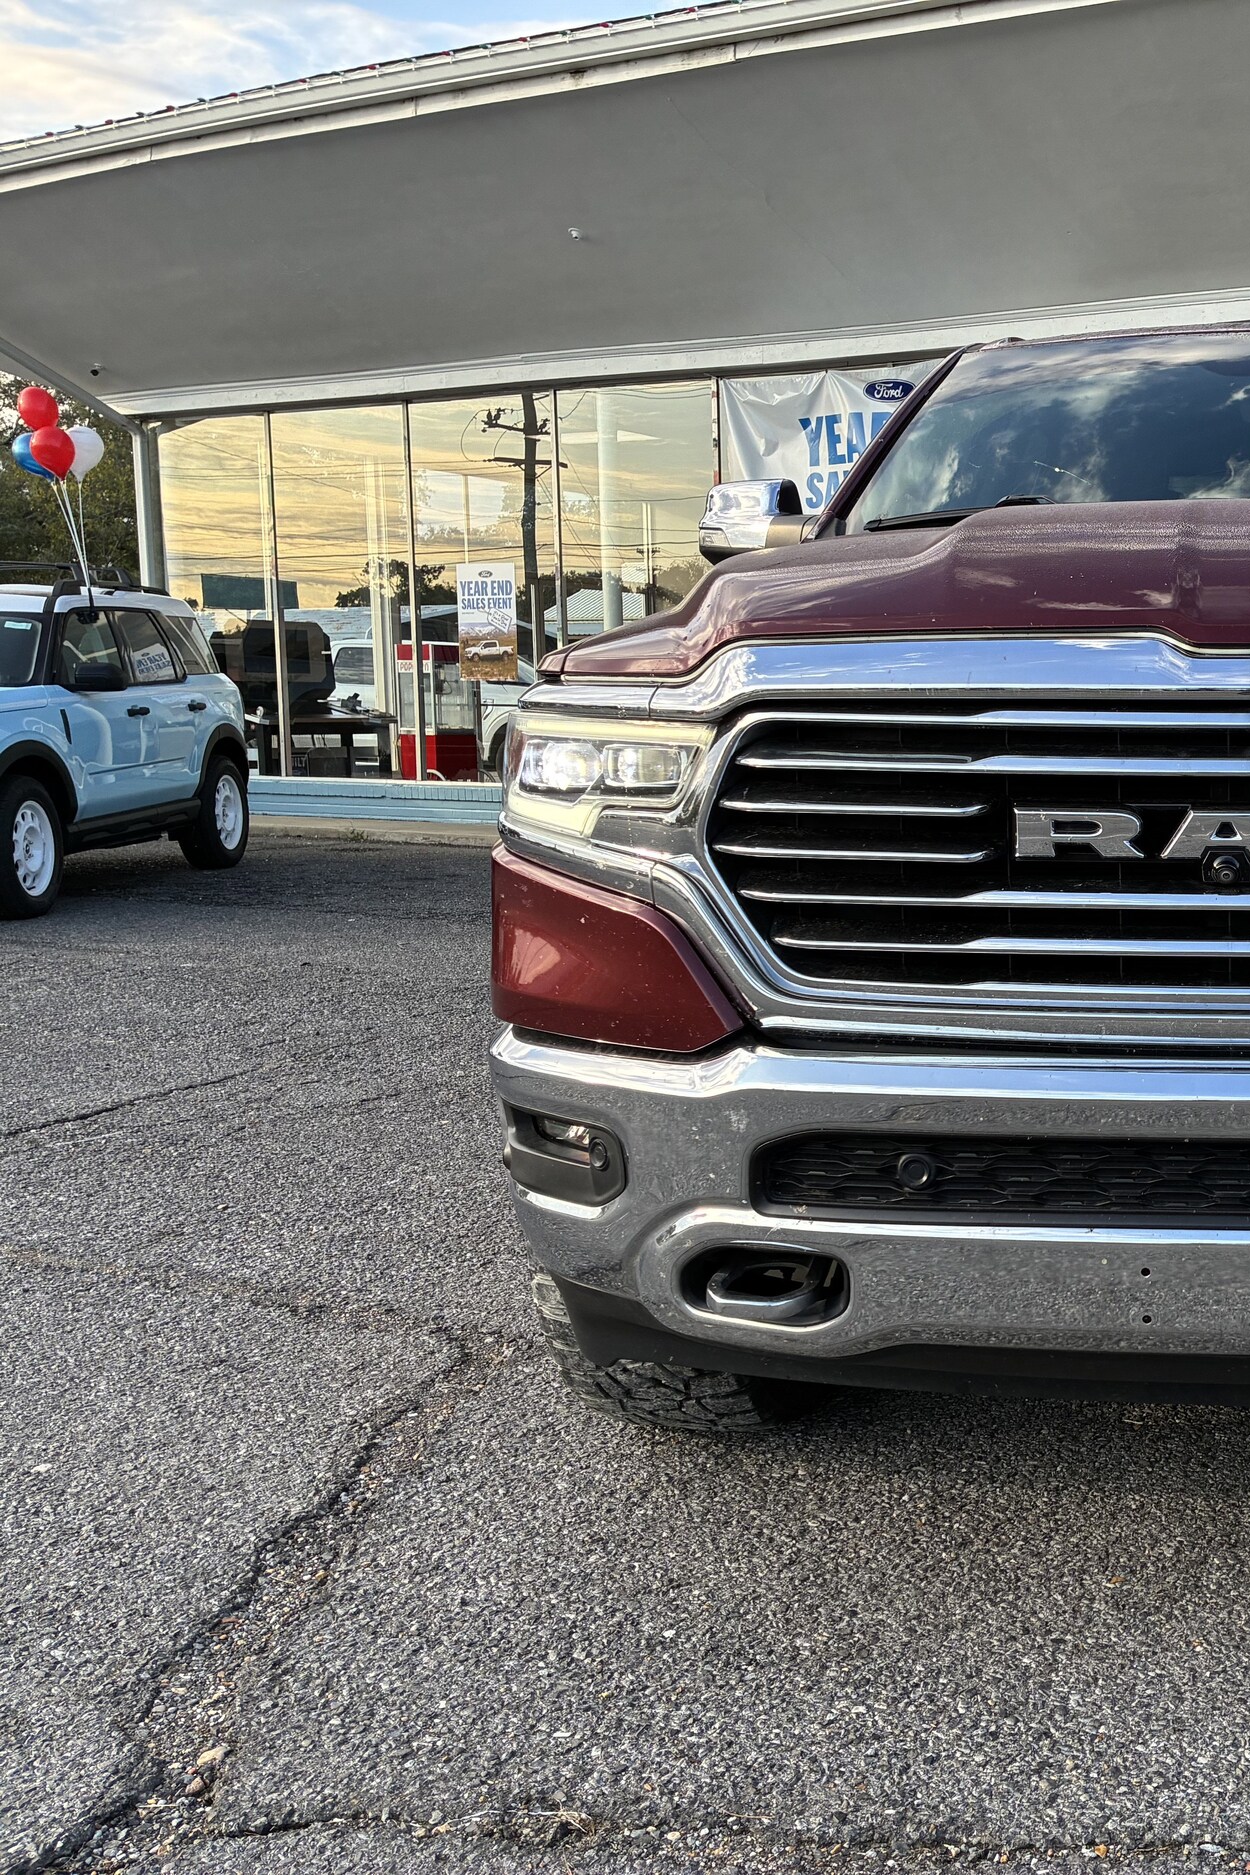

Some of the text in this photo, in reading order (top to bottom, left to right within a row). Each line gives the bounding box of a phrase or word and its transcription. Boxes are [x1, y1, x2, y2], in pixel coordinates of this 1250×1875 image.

[873, 383, 903, 399] Ford
[460, 580, 513, 596] YEAR END
[462, 597, 512, 610] SALES EVENT
